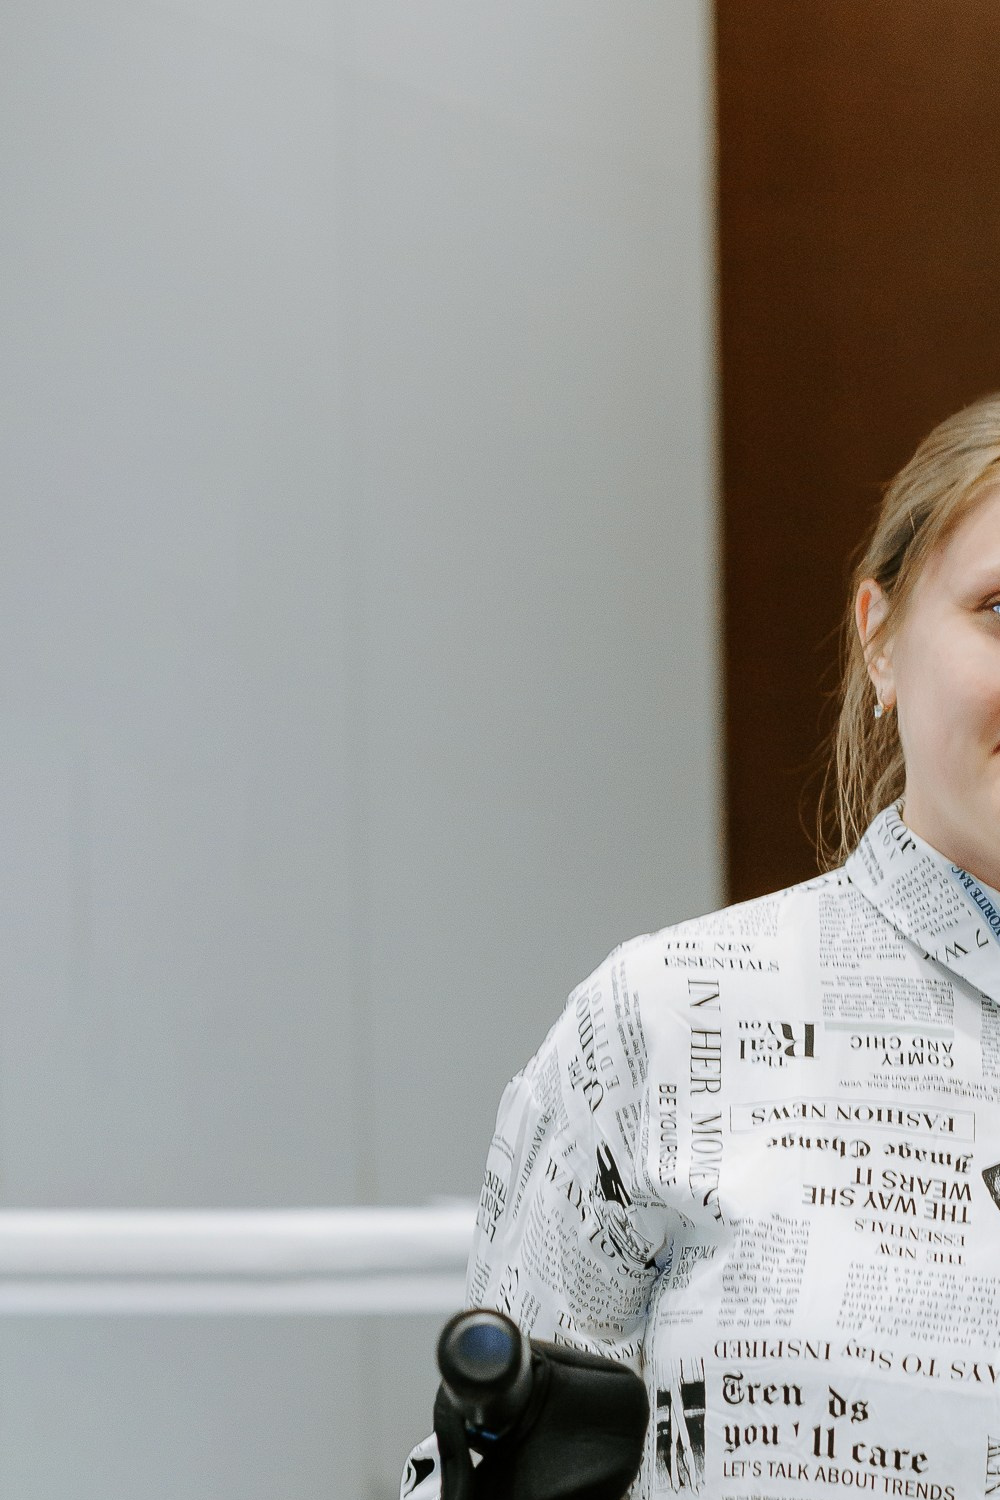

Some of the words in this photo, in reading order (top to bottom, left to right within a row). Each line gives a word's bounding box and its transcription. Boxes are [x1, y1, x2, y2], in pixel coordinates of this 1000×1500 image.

[687, 977, 722, 1013] IN
[850, 1035, 902, 1051] CHIC
[911, 1038, 954, 1054] AND
[688, 1026, 724, 1097] HER
[881, 1052, 955, 1069] COMFY
[658, 1083, 678, 1107] BE
[751, 1104, 827, 1127] NEWS
[835, 1104, 955, 1134] FASHION
[658, 1109, 679, 1188] YOURSELF
[766, 1132, 872, 1160] Change
[886, 1142, 975, 1174] Image
[851, 1165, 873, 1189] IT
[881, 1168, 973, 1202] WEARS
[802, 1184, 855, 1208] SHE
[864, 1191, 918, 1216] WAY
[924, 1201, 973, 1225] THE
[854, 1218, 967, 1247] ESSENTIALS
[876, 1241, 918, 1260] NEW
[928, 1250, 968, 1266] THE
[713, 1338, 832, 1362] INSPIRED
[901, 1352, 941, 1380] TO
[851, 1439, 930, 1475] care
[722, 1460, 763, 1479] LET'S
[769, 1461, 812, 1483] TALK
[814, 1465, 879, 1493] ABOUT
